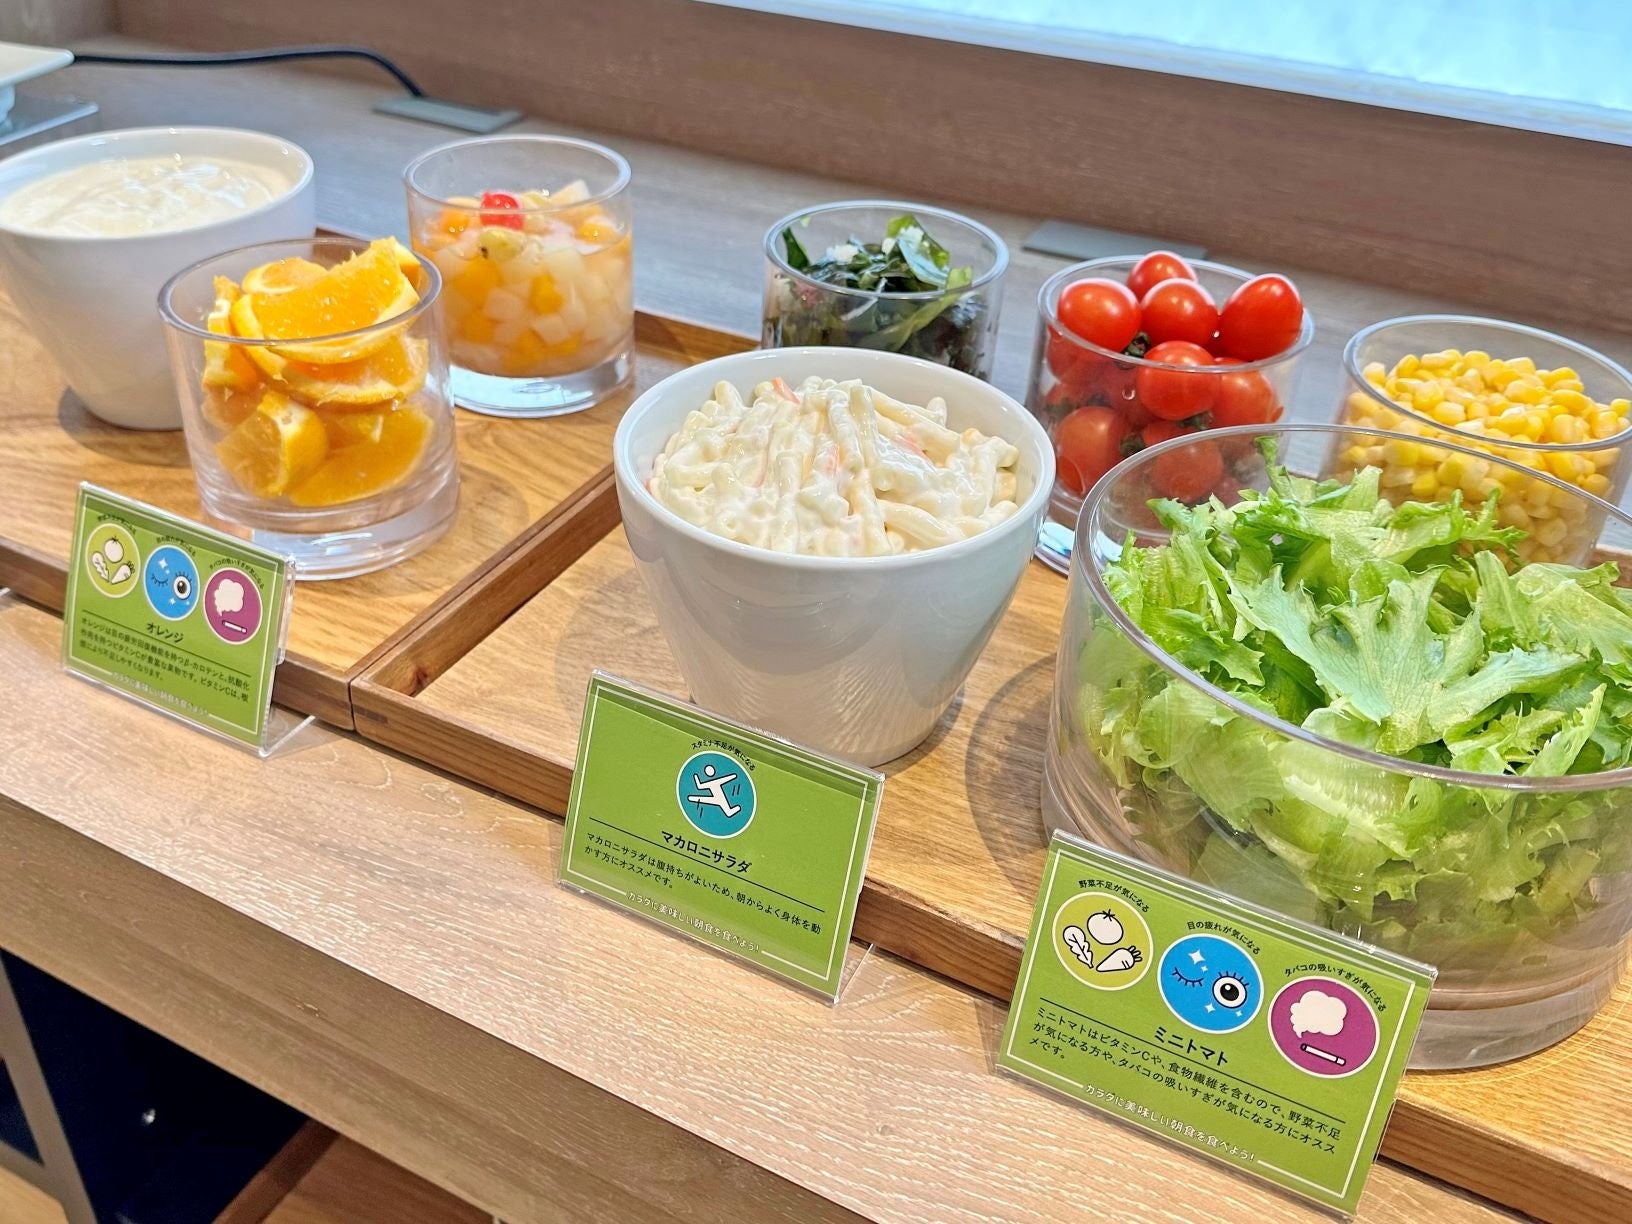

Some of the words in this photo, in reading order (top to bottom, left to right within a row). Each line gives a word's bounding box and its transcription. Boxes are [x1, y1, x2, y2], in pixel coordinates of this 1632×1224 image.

[146, 622, 184, 643] オレンジ
[691, 739, 756, 771] スタミナ不足が気になる
[584, 845, 673, 889] かす方にオススメです。
[661, 830, 753, 873] マカロニサラダ
[587, 832, 822, 935] マカロニサラダは腹持ちがよいため、朝からよく身体を動
[1078, 879, 1150, 913] 野菜不足が気になる
[1187, 921, 1261, 955] 目の疲れが気になる
[1284, 963, 1387, 1012] タバコの吸いすぎが気になる
[1029, 1037, 1065, 1059] メです。
[1154, 1026, 1228, 1066] ミニトマト
[1033, 1022, 1336, 1155] が気になる方や、タバコの吸いすぎが気になる方にオスス
[1037, 1007, 1341, 1141] ミニトマトはビタミンCや、食物繊維を含むので、野菜不足
[1086, 1083, 1255, 1162] カラダに美味しい朝食を食べよう!
